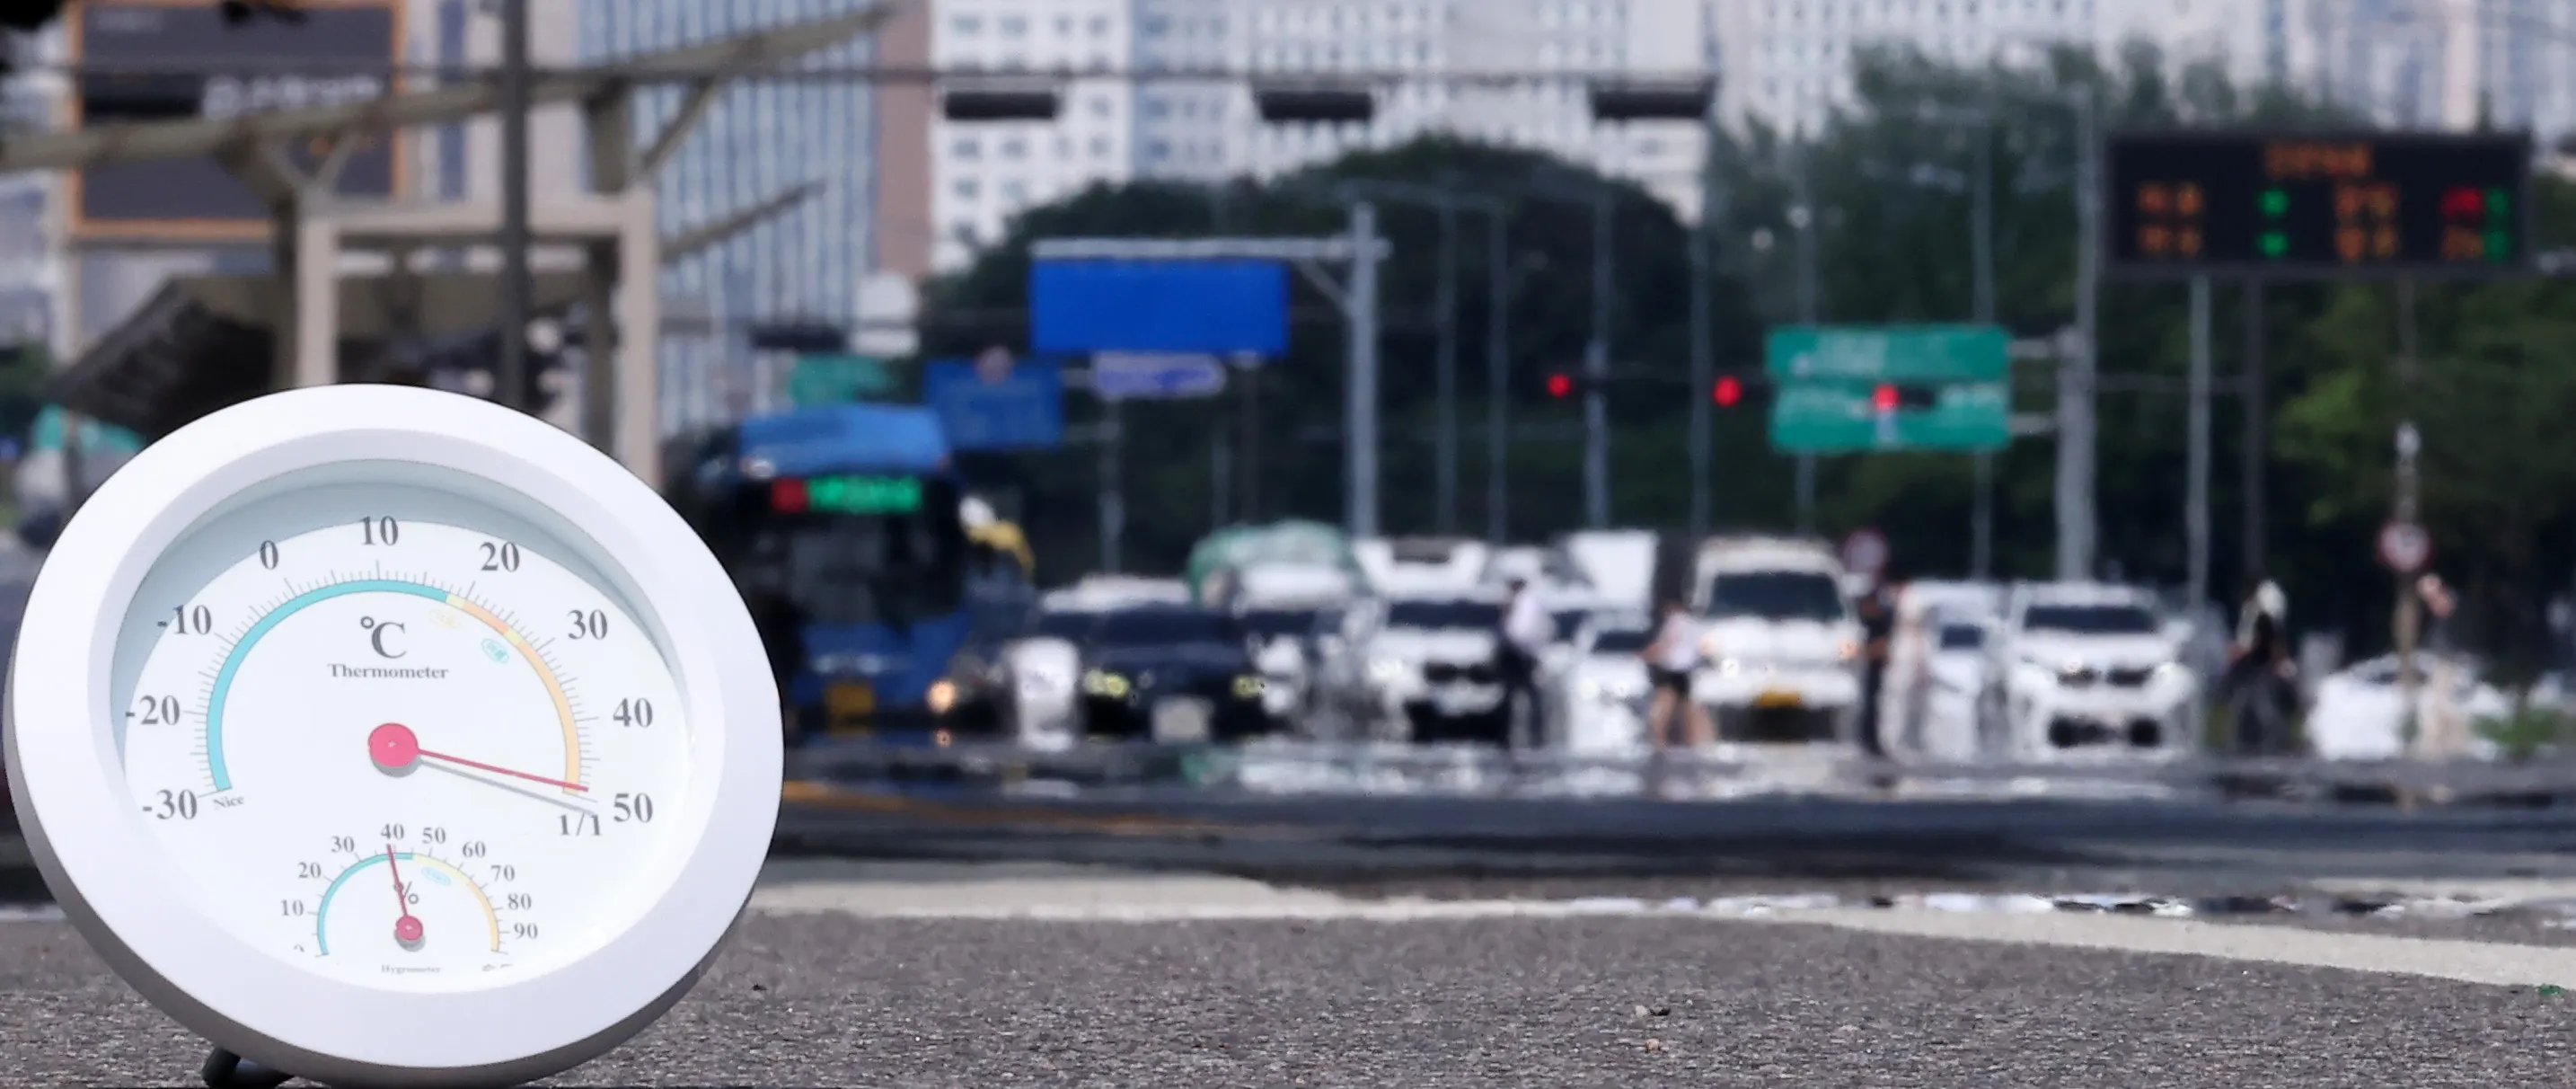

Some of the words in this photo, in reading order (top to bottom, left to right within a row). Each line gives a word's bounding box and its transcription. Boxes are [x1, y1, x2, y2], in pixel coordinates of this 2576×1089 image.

[360, 515, 399, 546] 10
[260, 540, 278, 570] 0
[479, 542, 520, 572] 20
[157, 605, 212, 634] -10
[568, 609, 608, 641] 30
[328, 663, 449, 679] Thermometer
[125, 695, 181, 725] -20
[613, 697, 653, 729] 40
[142, 789, 198, 819] -30
[613, 792, 653, 823] 50
[381, 823, 404, 840] 40
[422, 827, 446, 845] 50
[331, 836, 355, 854] 30
[463, 841, 486, 858] 60
[298, 862, 322, 879] 20
[491, 864, 515, 881] 70
[281, 899, 304, 916] 10
[507, 893, 532, 910] 80
[514, 923, 538, 940] 90
